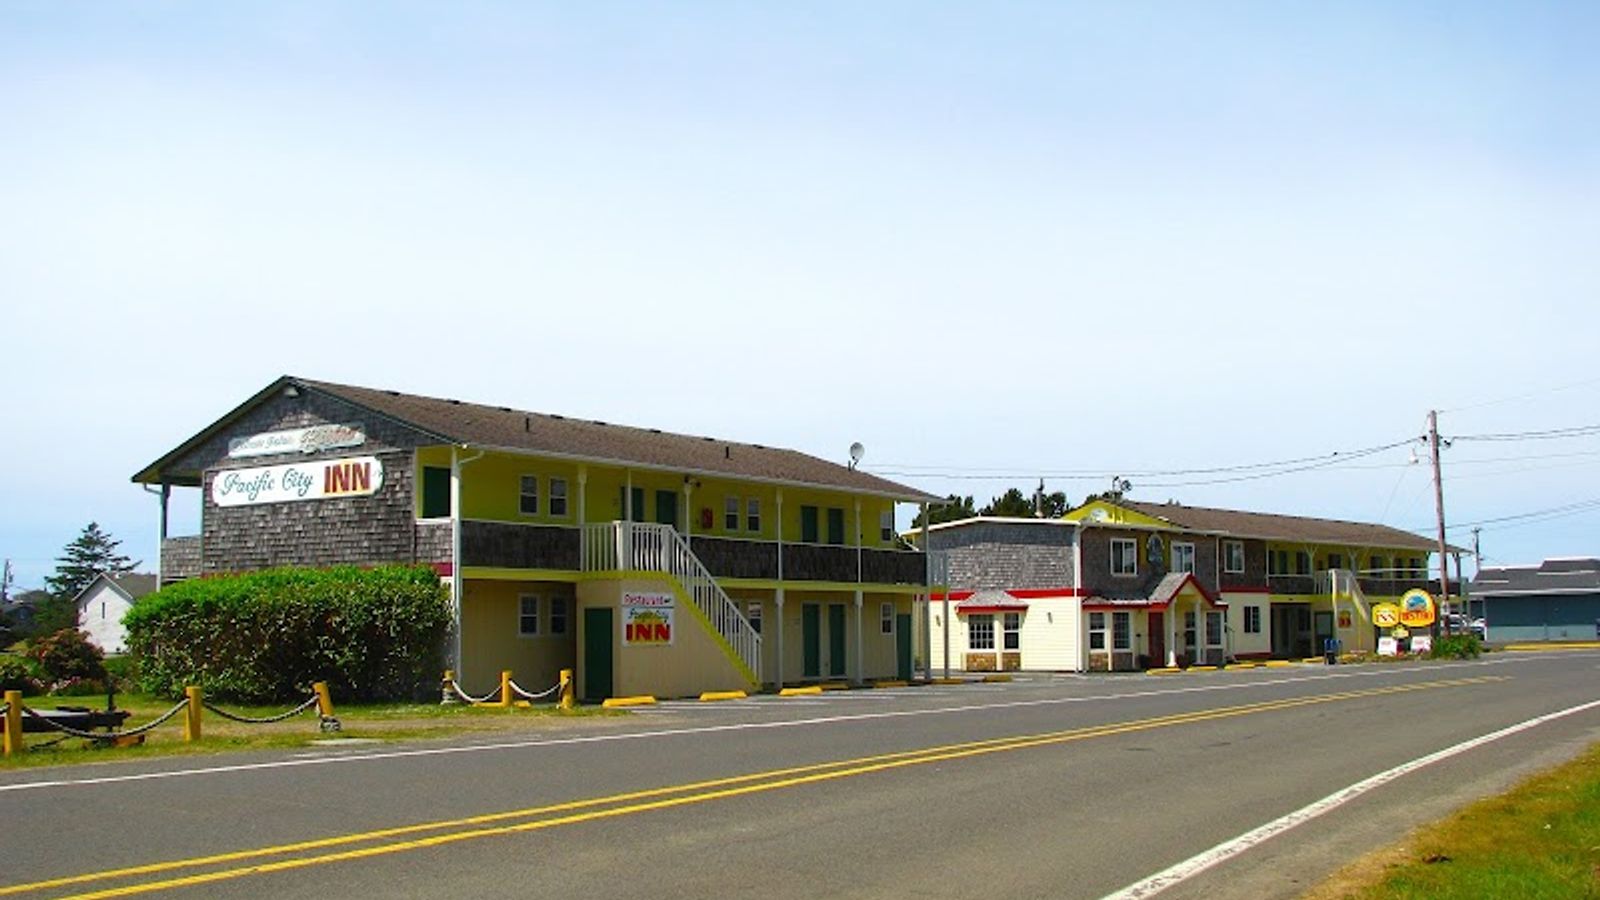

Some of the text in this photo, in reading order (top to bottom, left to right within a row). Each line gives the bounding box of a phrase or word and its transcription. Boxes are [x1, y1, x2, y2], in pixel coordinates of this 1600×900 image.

[221, 462, 371, 501] Pacific City INN
[626, 624, 671, 641] INN
